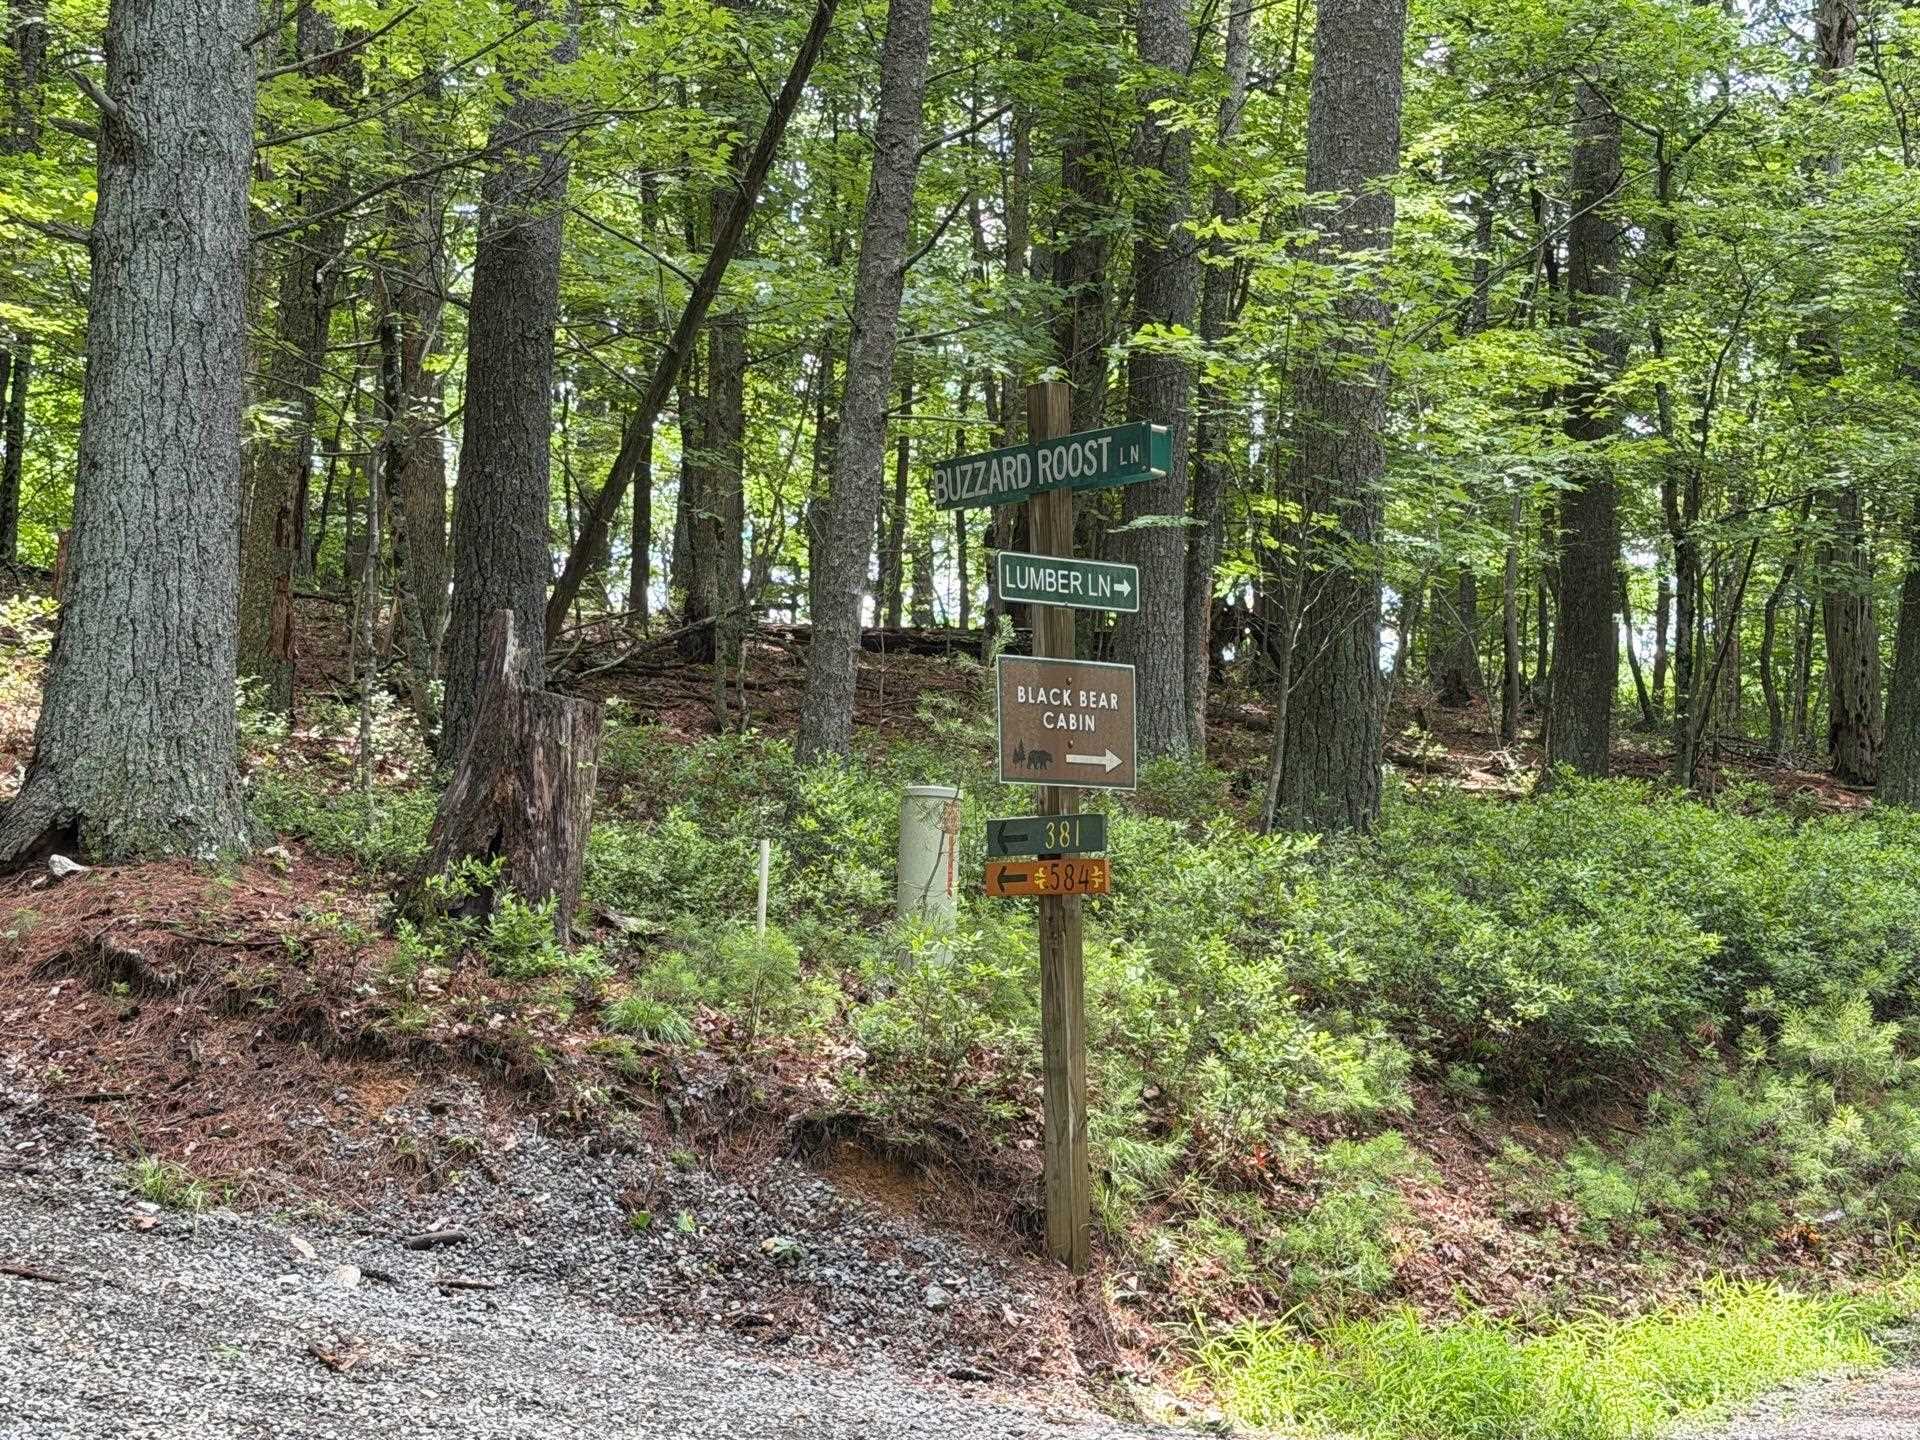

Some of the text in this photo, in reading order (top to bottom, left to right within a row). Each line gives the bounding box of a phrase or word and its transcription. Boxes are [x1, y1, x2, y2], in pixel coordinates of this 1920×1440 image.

[934, 436, 1139, 505] BUZZARD ROOST LN
[1006, 564, 1111, 598] LUMBER LN
[1017, 685, 1119, 710] BLACK BEAR
[1043, 711, 1096, 731] CABIN
[1045, 820, 1079, 849] 381
[1050, 863, 1089, 891] 584
